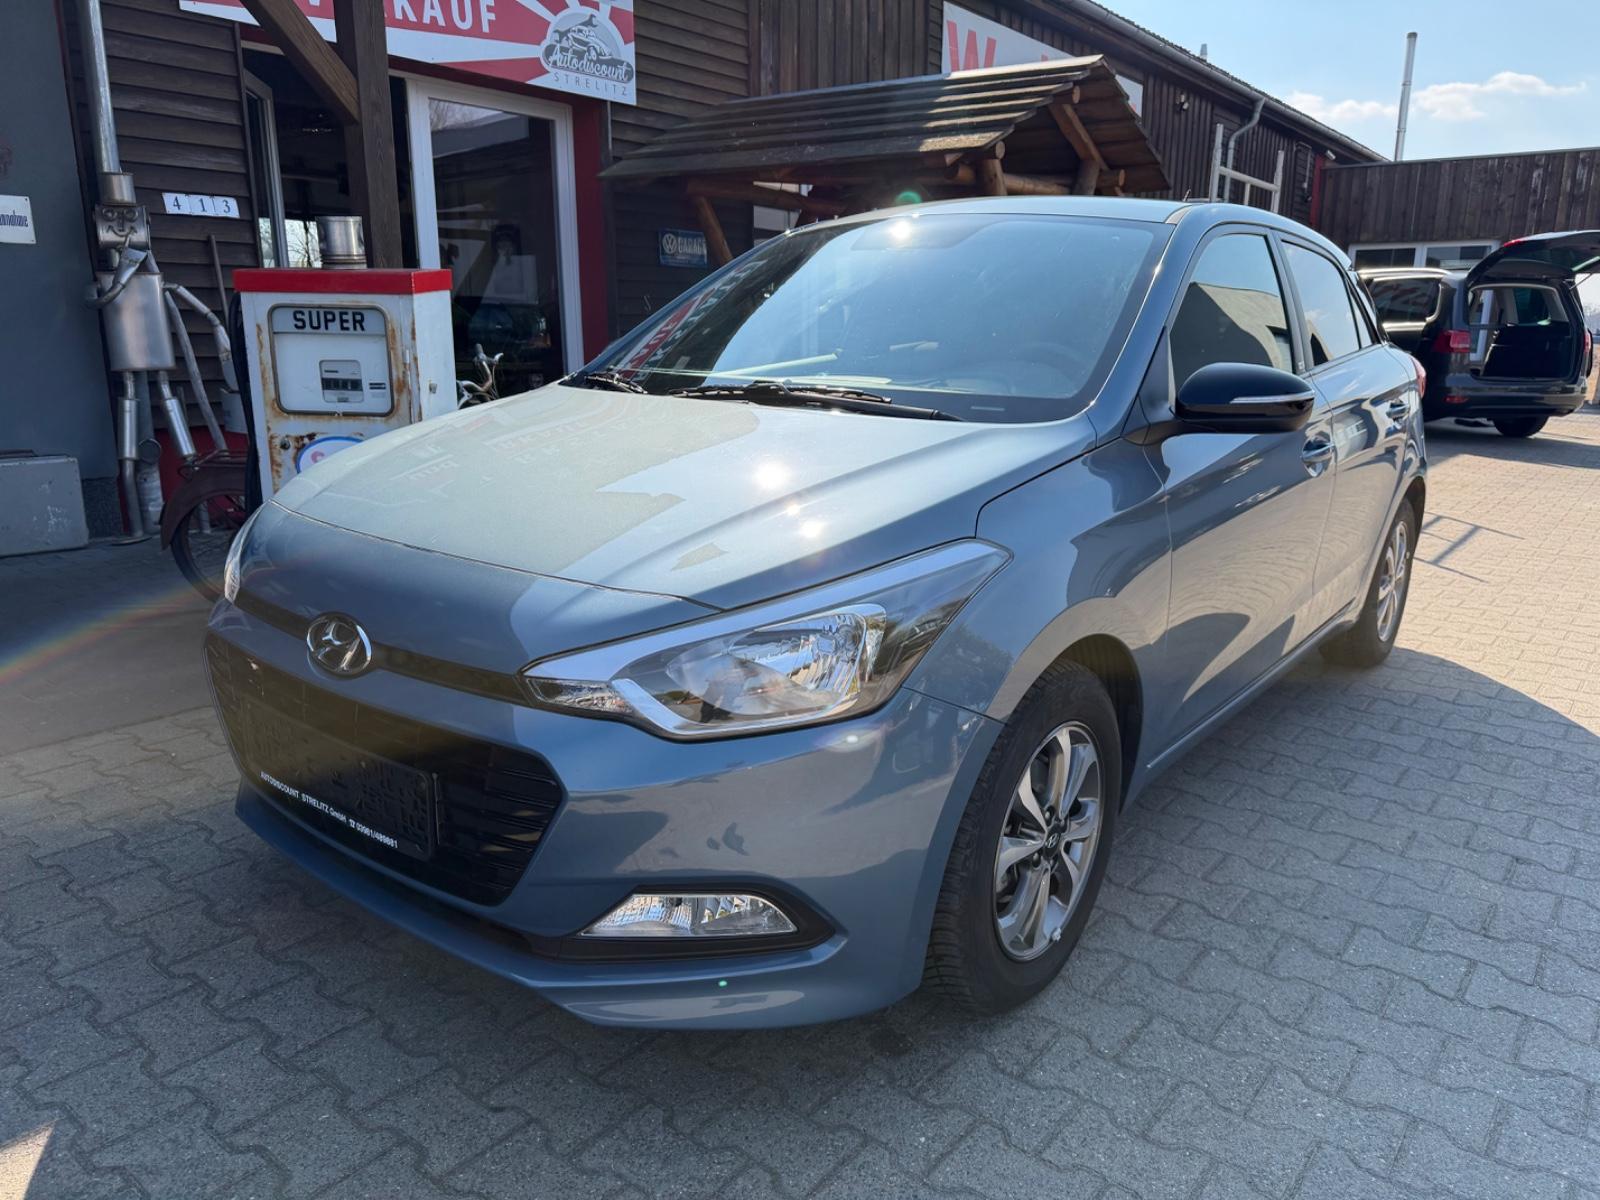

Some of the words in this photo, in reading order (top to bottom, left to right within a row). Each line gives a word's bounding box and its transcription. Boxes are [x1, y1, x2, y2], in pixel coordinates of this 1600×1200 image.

[548, 45, 632, 81] Autodiscount
[553, 71, 628, 96] STRELITZ
[292, 310, 366, 332] SUPER
[260, 770, 301, 799] AUTODISCOUNT
[301, 792, 329, 814] STRELITZ
